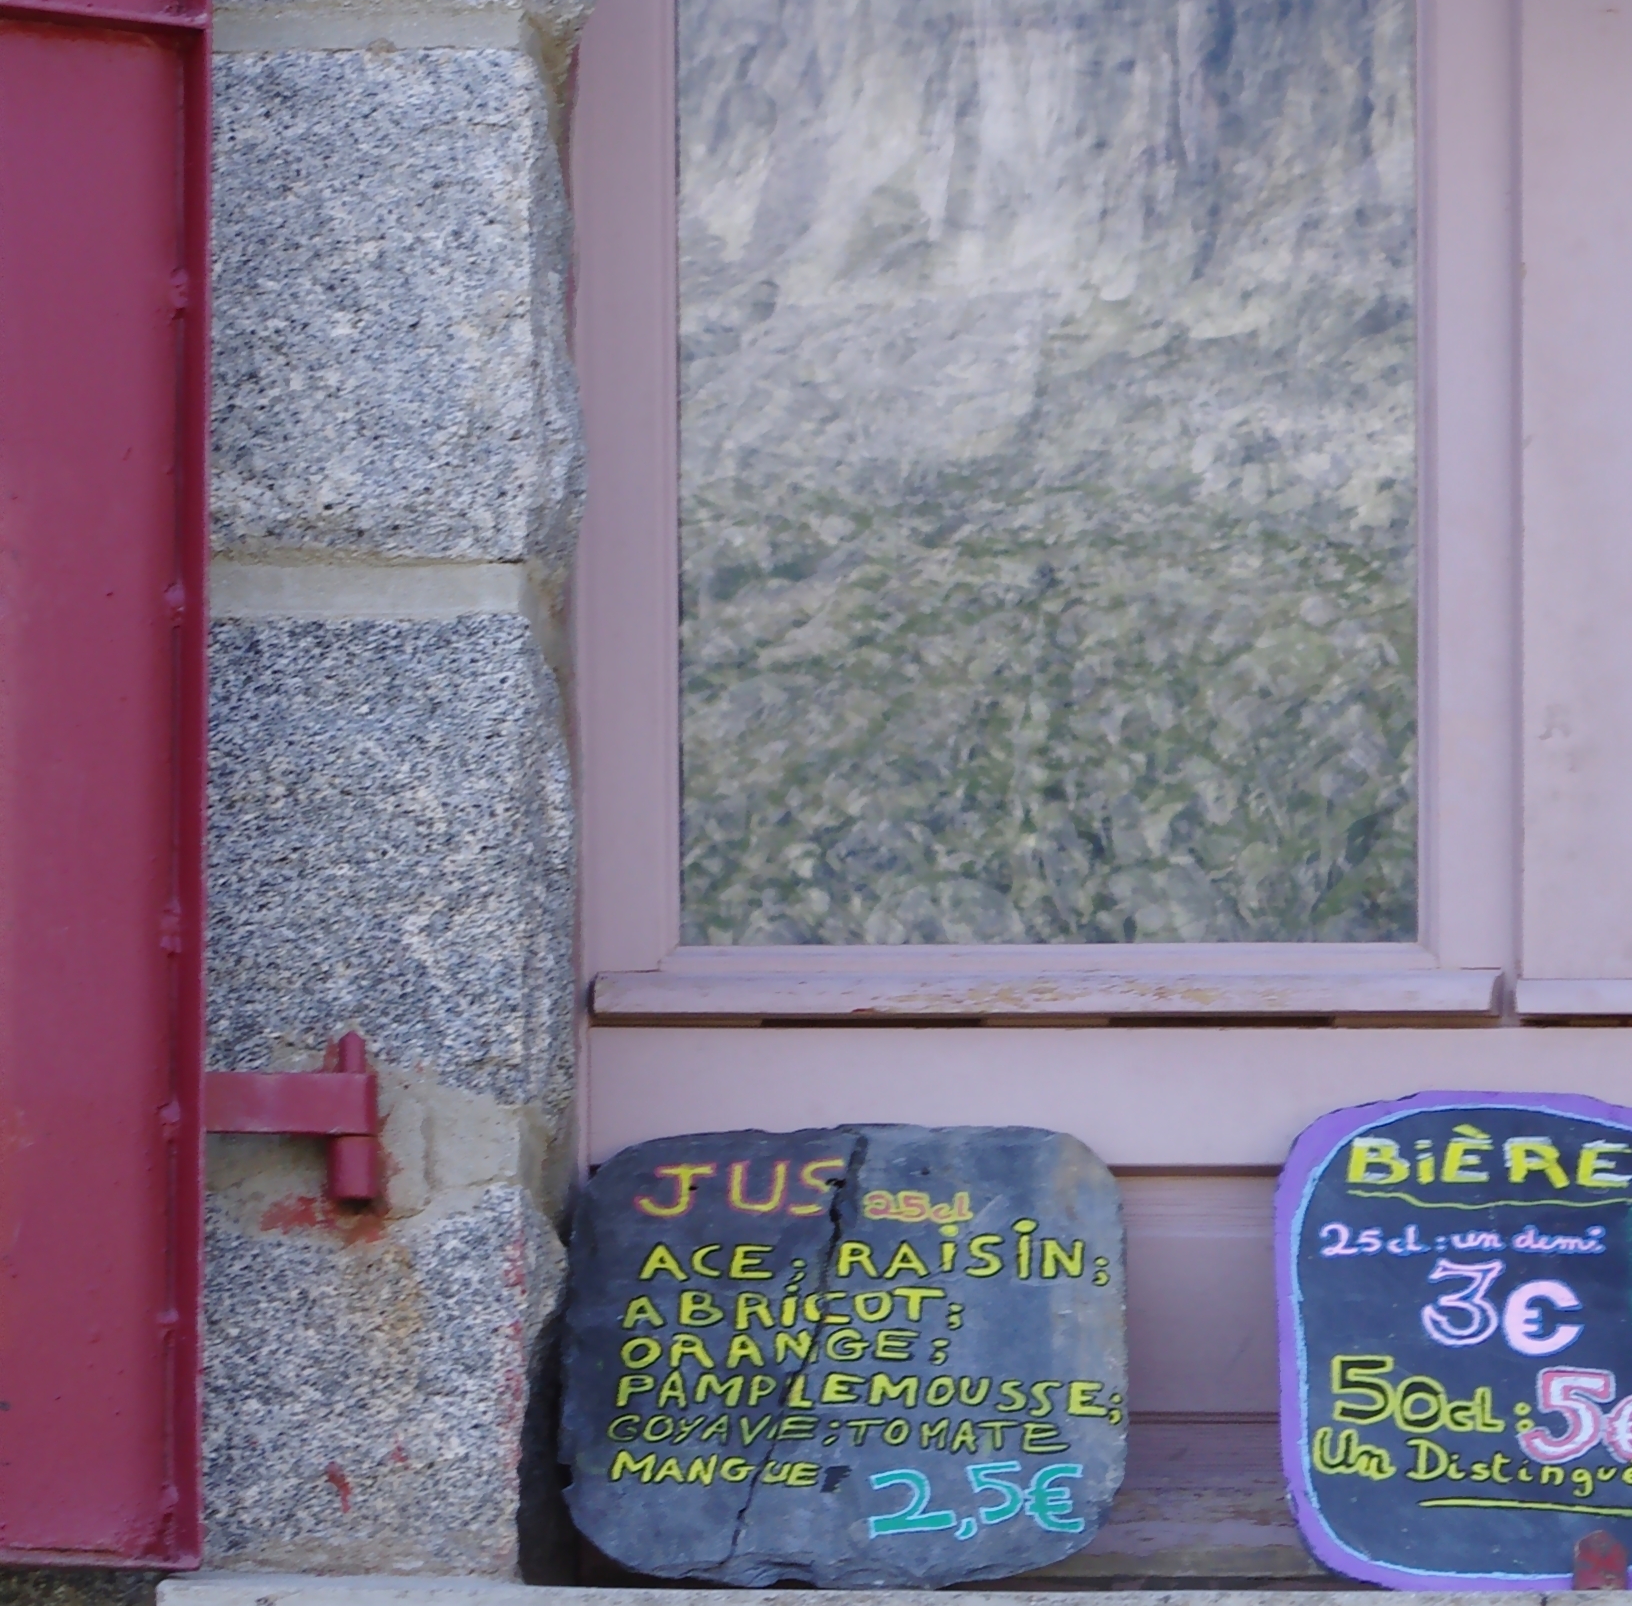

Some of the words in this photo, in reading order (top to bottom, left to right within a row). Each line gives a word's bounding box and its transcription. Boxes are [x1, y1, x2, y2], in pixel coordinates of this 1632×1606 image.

[634, 1158, 845, 1218] JUS
[864, 1189, 973, 1223] 25cl
[1452, 1230, 1504, 1251] un
[1511, 1224, 1607, 1255] demi
[1420, 1258, 1585, 1357] 3€
[845, 1418, 1071, 1453] TOMATE
[609, 1449, 821, 1489] MANGUE
[868, 1459, 1086, 1541] 2,5€
